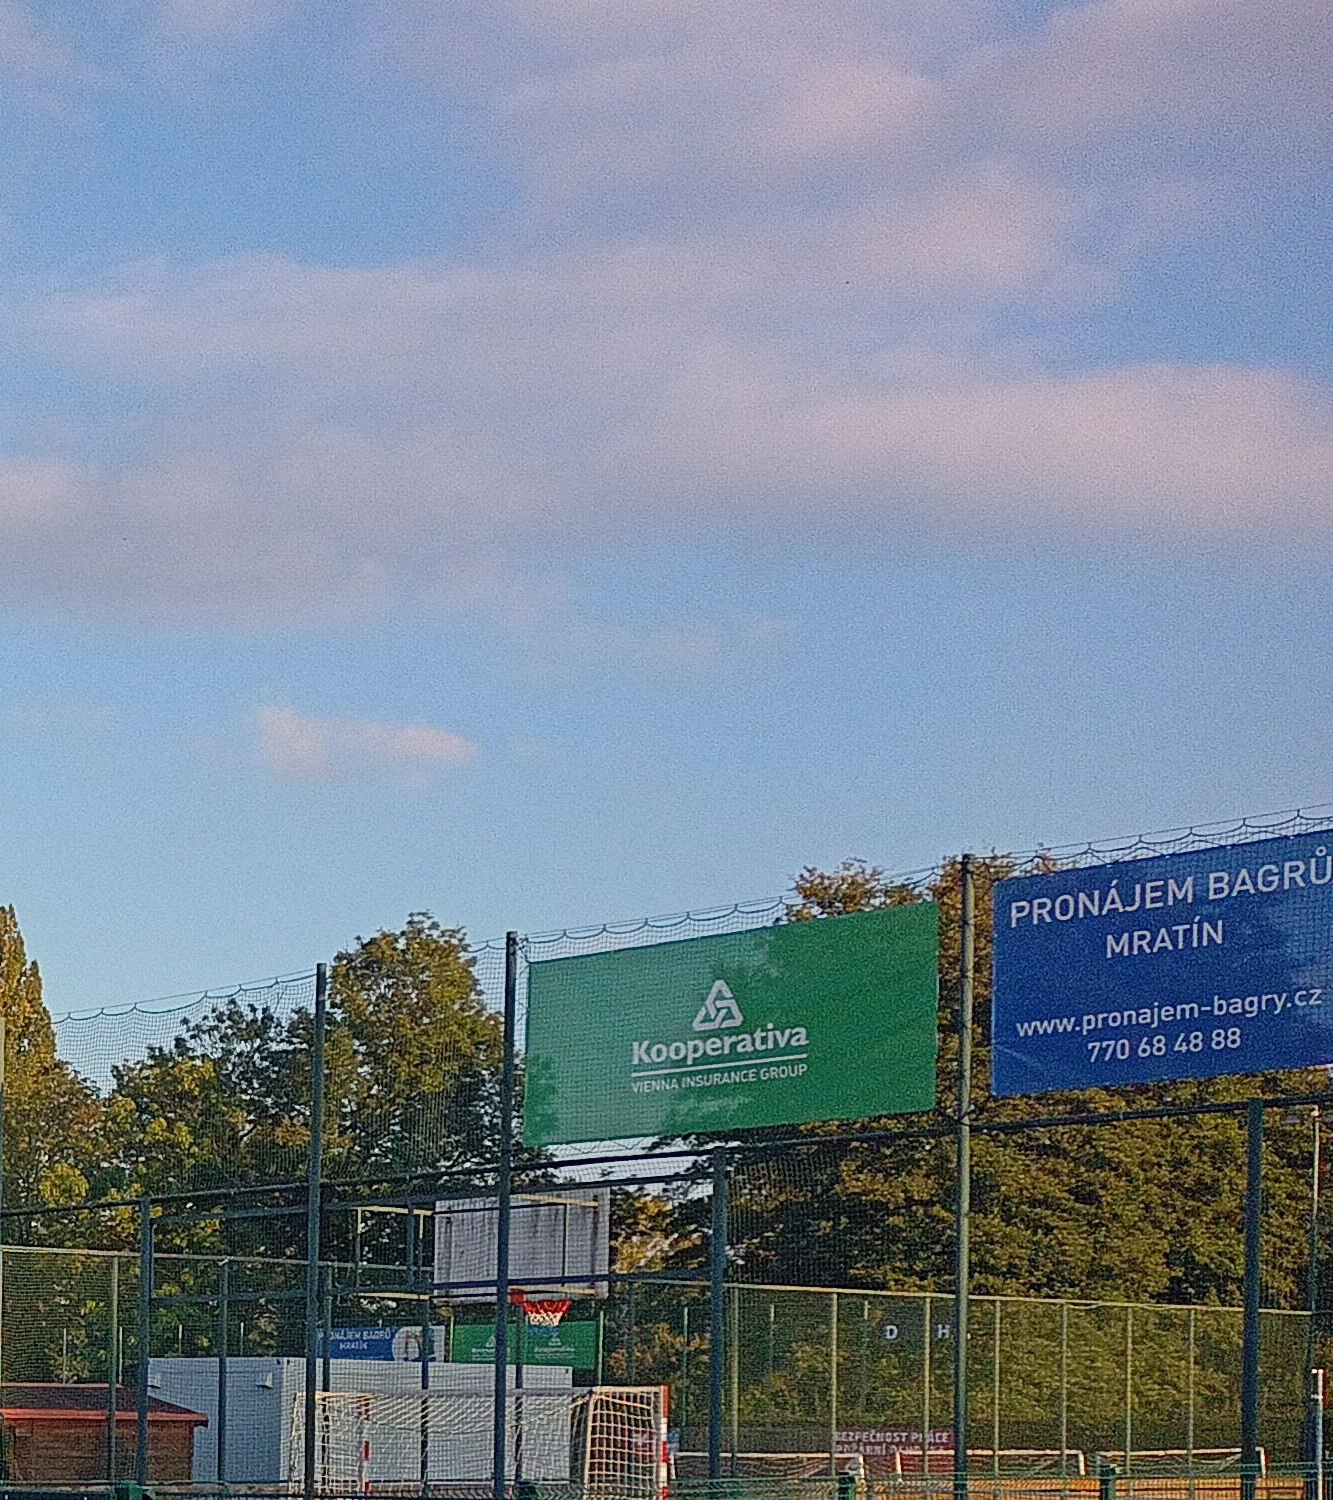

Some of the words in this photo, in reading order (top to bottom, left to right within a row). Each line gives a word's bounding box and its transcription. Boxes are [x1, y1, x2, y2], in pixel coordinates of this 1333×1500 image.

[1010, 876, 1194, 929] PRONÁJEM
[1105, 915, 1224, 959] MRATÍN
[1016, 988, 1323, 1037] www.pronajem-bagry.cz
[632, 1023, 810, 1065] Kooperativa
[1087, 1039, 1130, 1063] 770
[1137, 1034, 1167, 1059] 68
[1173, 1030, 1204, 1055] 48
[1211, 1026, 1242, 1050] 88
[631, 1077, 679, 1093] VIENNA
[681, 1068, 758, 1089] INSURANCE
[760, 1063, 809, 1081] GROUP
